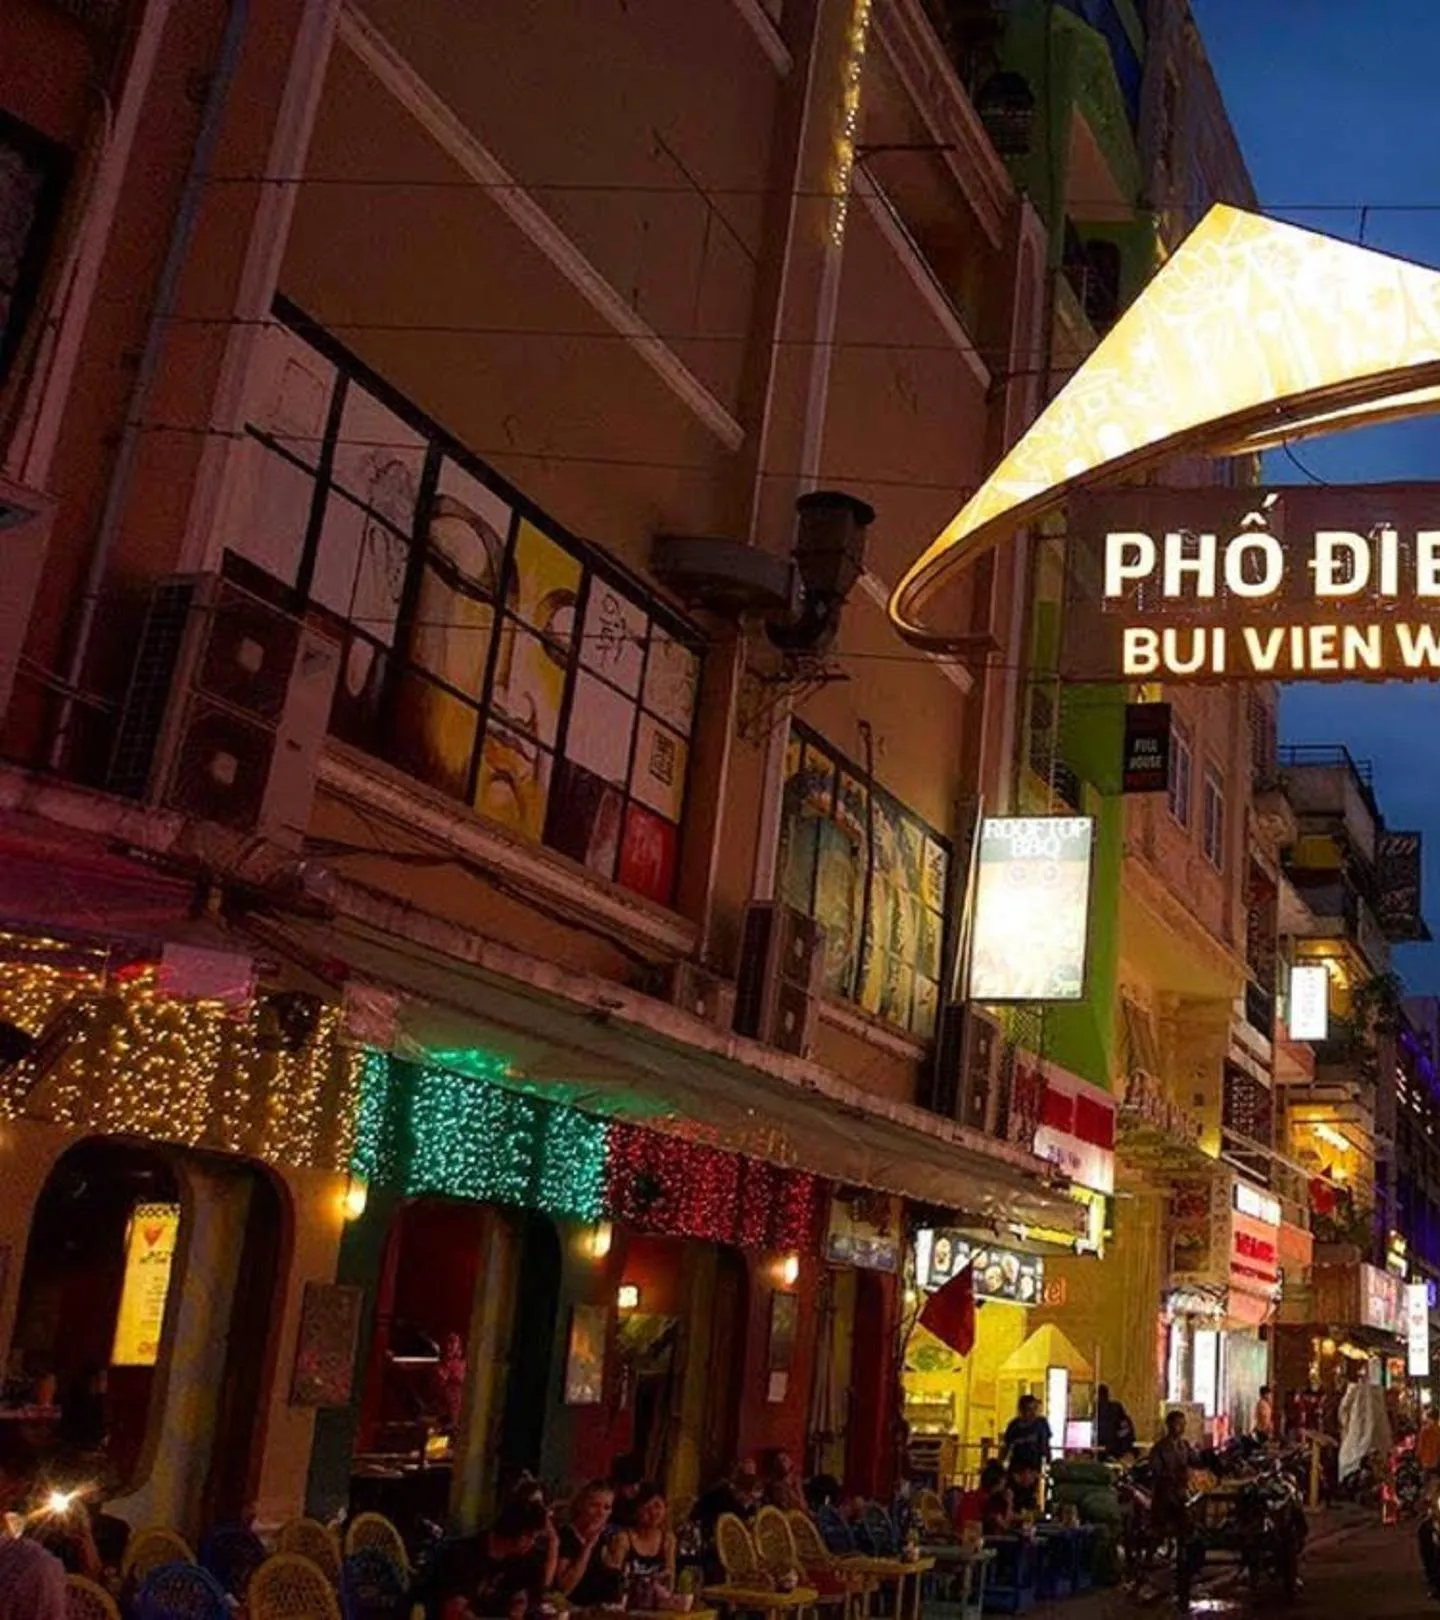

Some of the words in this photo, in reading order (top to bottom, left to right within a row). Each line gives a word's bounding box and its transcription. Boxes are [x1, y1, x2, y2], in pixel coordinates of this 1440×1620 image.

[1104, 492, 1285, 598] PHỐ
[1307, 530, 1399, 597] ĐI
[1122, 627, 1226, 675] BUI
[1242, 624, 1382, 672] VIEN
